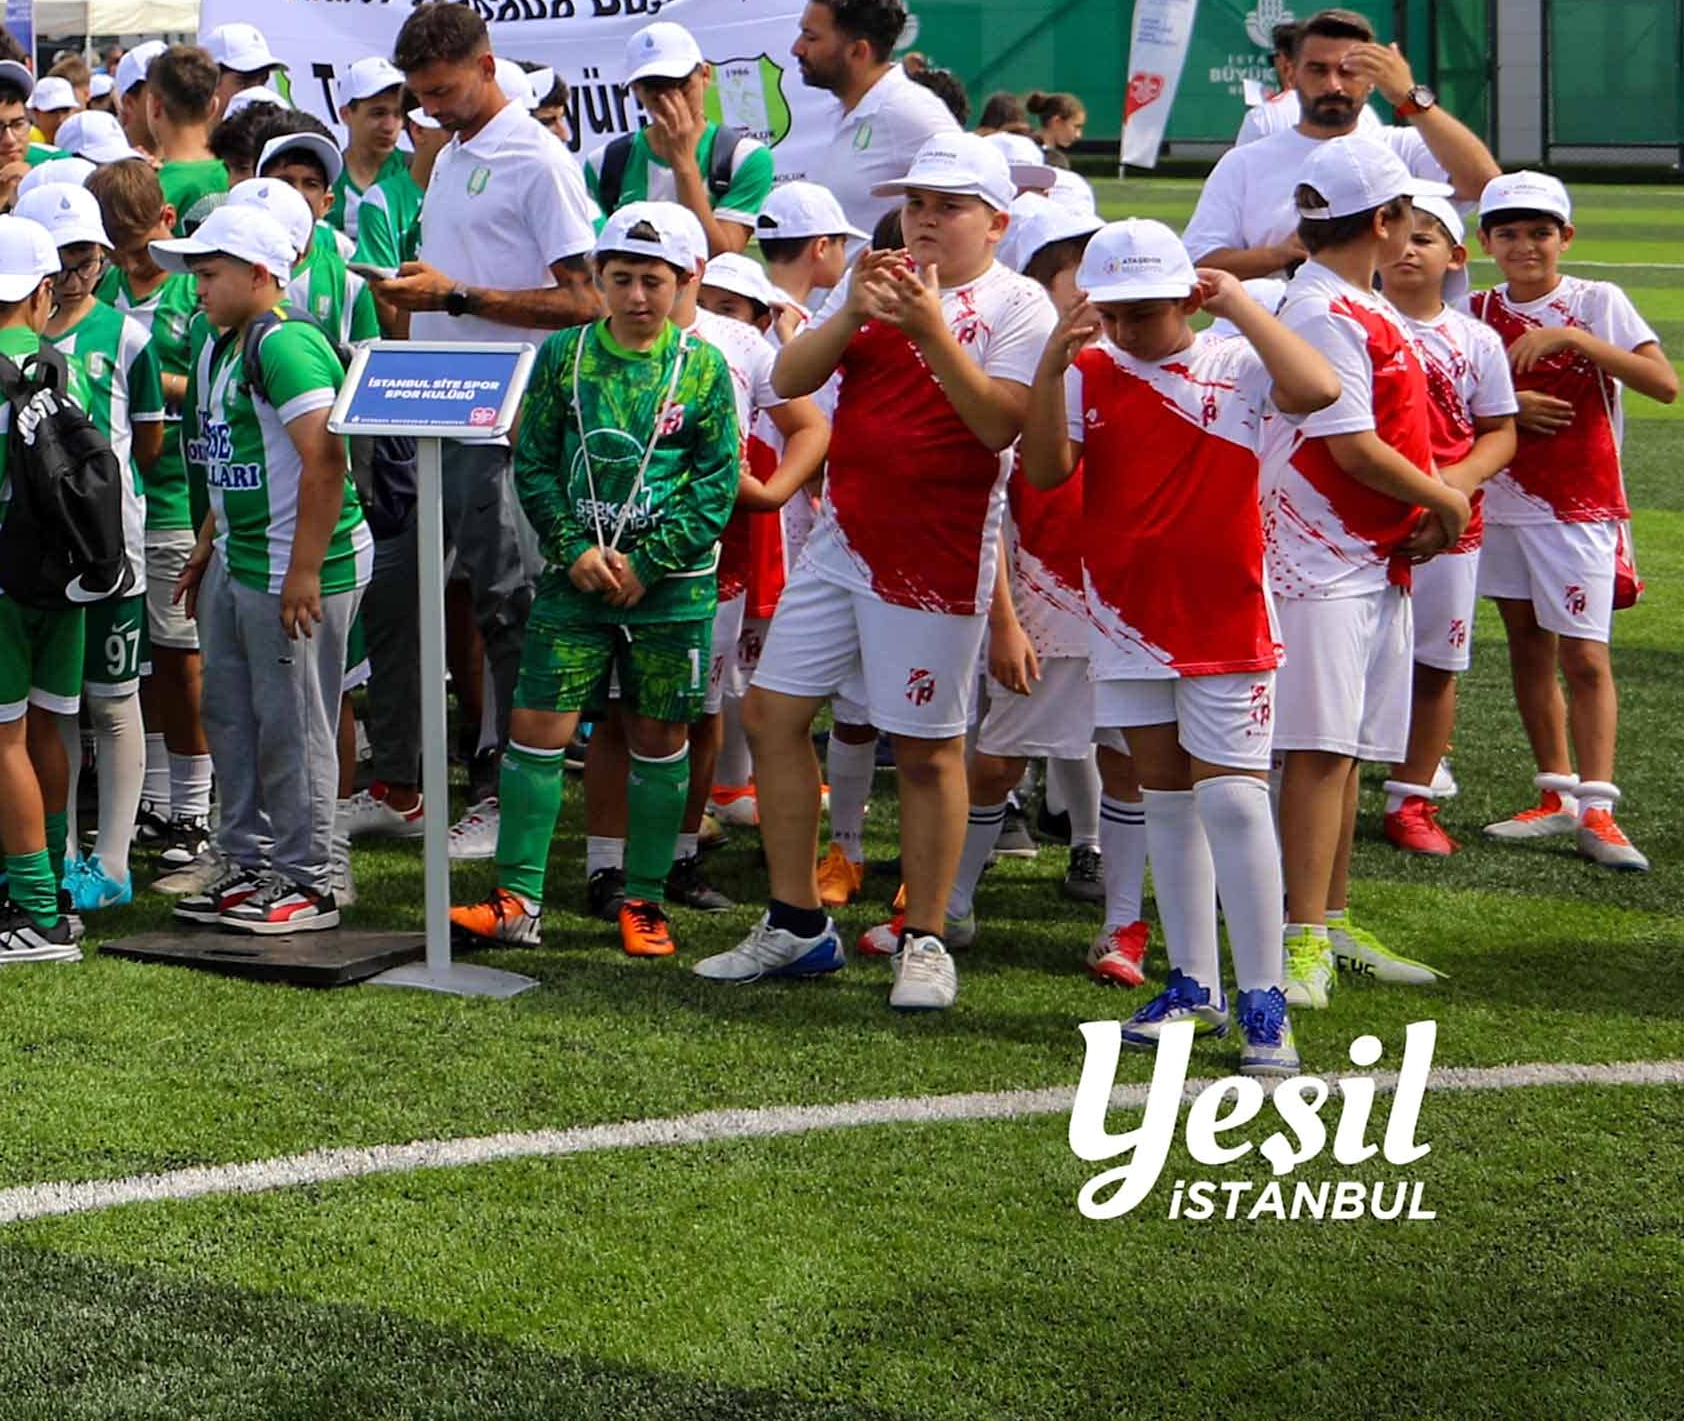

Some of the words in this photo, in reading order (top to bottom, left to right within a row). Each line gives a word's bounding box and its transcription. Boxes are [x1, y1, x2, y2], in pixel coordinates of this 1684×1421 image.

[368, 377, 431, 389] İSTANBUL
[433, 378, 461, 389] SİTE
[463, 380, 501, 391] SPOR
[384, 390, 420, 399] SPOR
[421, 389, 475, 401] KULÜBÜ
[104, 627, 141, 677] 97
